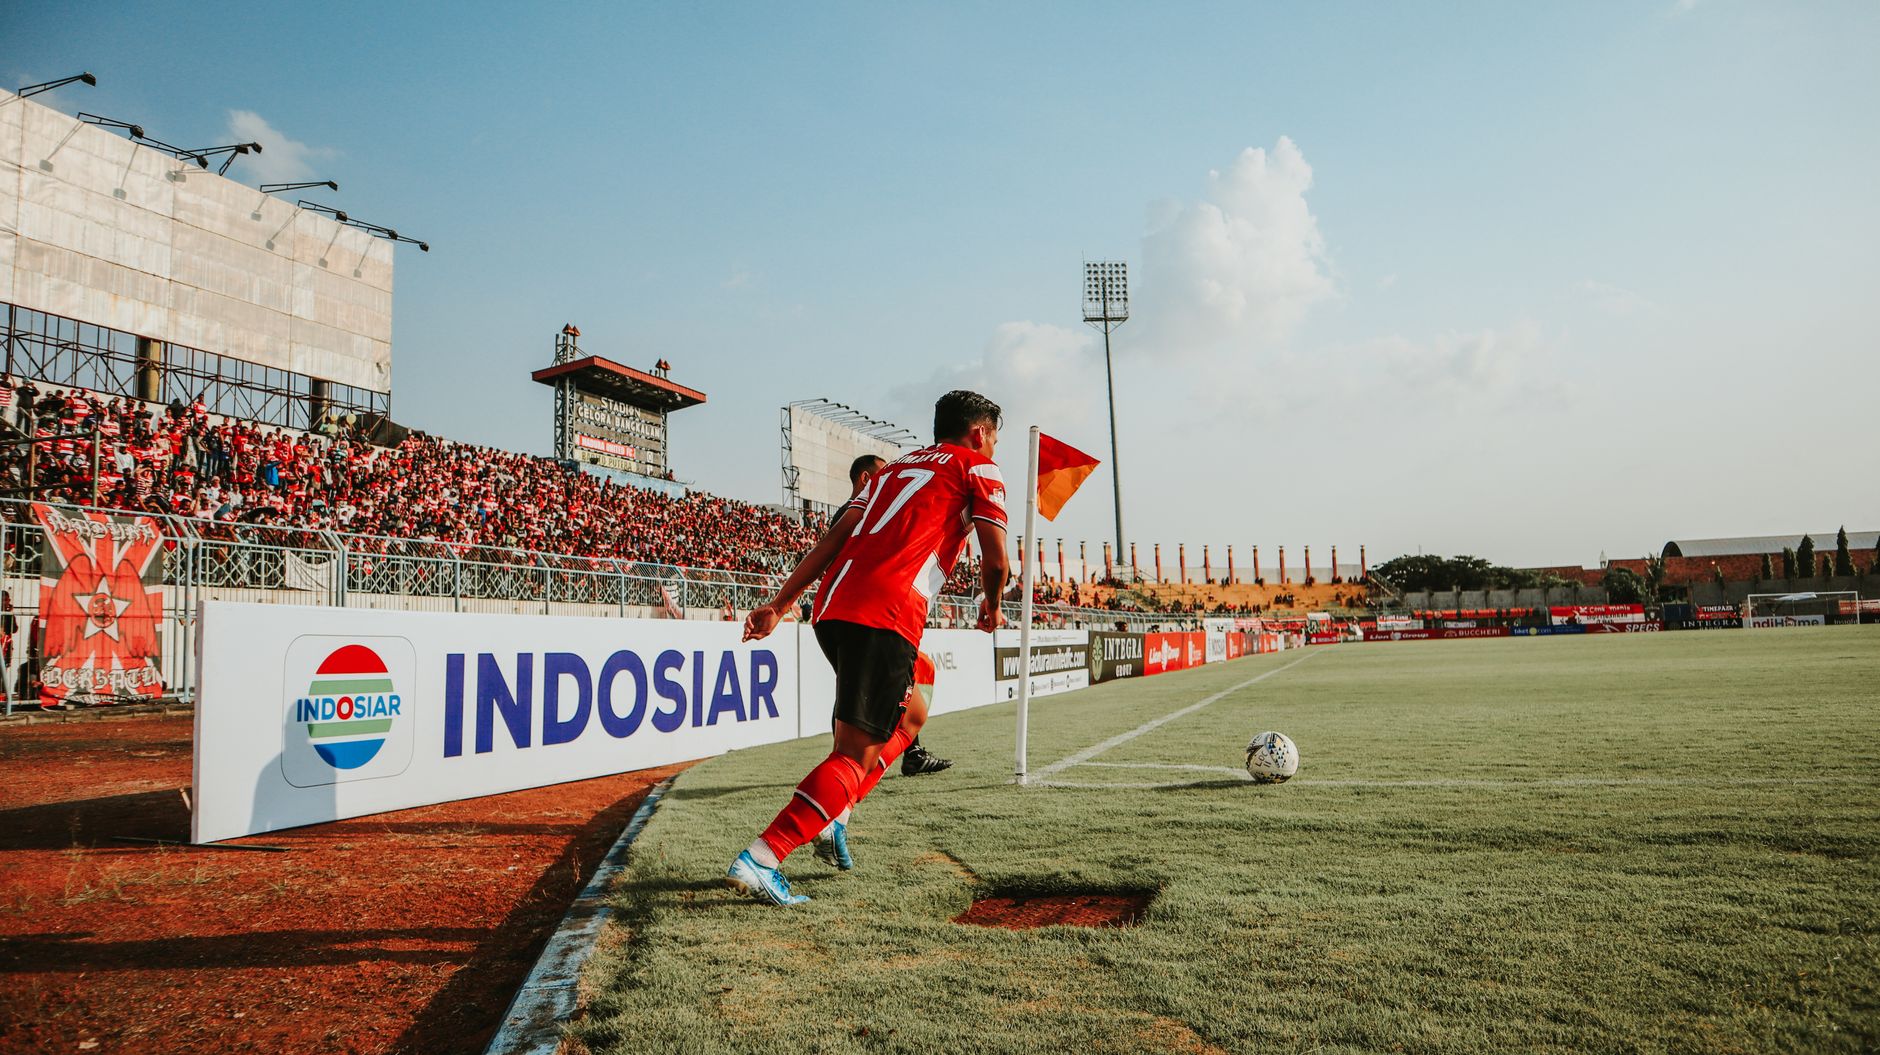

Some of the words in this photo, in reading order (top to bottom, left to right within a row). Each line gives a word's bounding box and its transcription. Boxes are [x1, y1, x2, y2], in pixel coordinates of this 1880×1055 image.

[601, 397, 640, 416] STADION
[578, 406, 611, 424] GELORA
[615, 417, 660, 438] BANGKALAN
[852, 468, 935, 537] 17
[1625, 623, 1660, 633] SPECS
[1682, 619, 1738, 628] INTEGRA
[1752, 616, 1820, 629] ndiHome
[1458, 628, 1500, 637] BUCCHERI
[1103, 637, 1142, 661] INTEGRA
[931, 652, 957, 671] NNEL
[1115, 663, 1133, 678] GROUP
[296, 694, 401, 722] INDOSIAR
[443, 649, 780, 758] INDOSIAR
